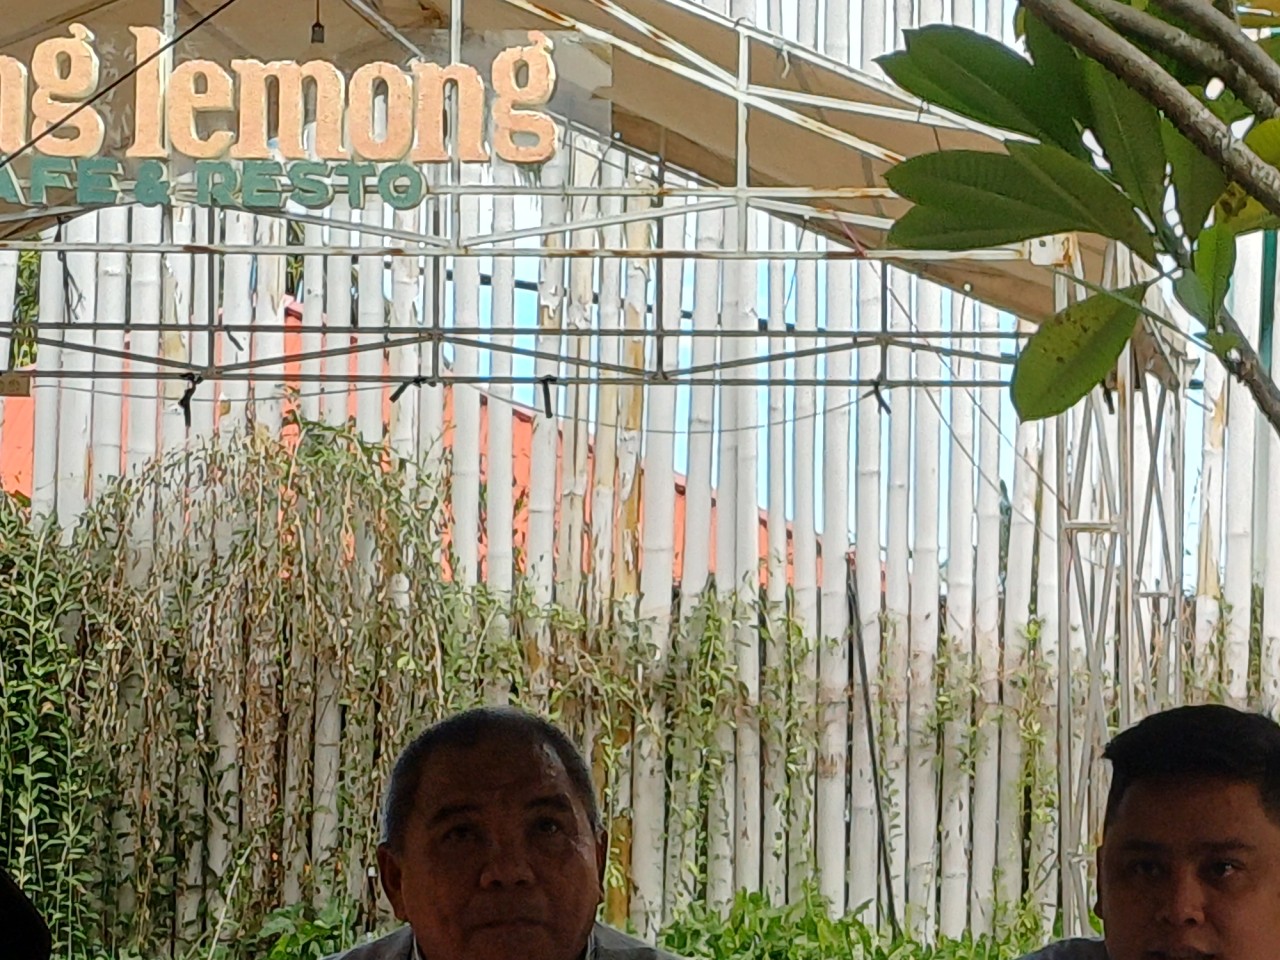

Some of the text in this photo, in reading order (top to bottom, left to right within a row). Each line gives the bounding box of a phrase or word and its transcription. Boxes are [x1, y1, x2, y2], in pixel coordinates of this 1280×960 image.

[129, 24, 562, 164] lemong
[134, 160, 172, 207] &
[196, 160, 427, 210] RESTO
